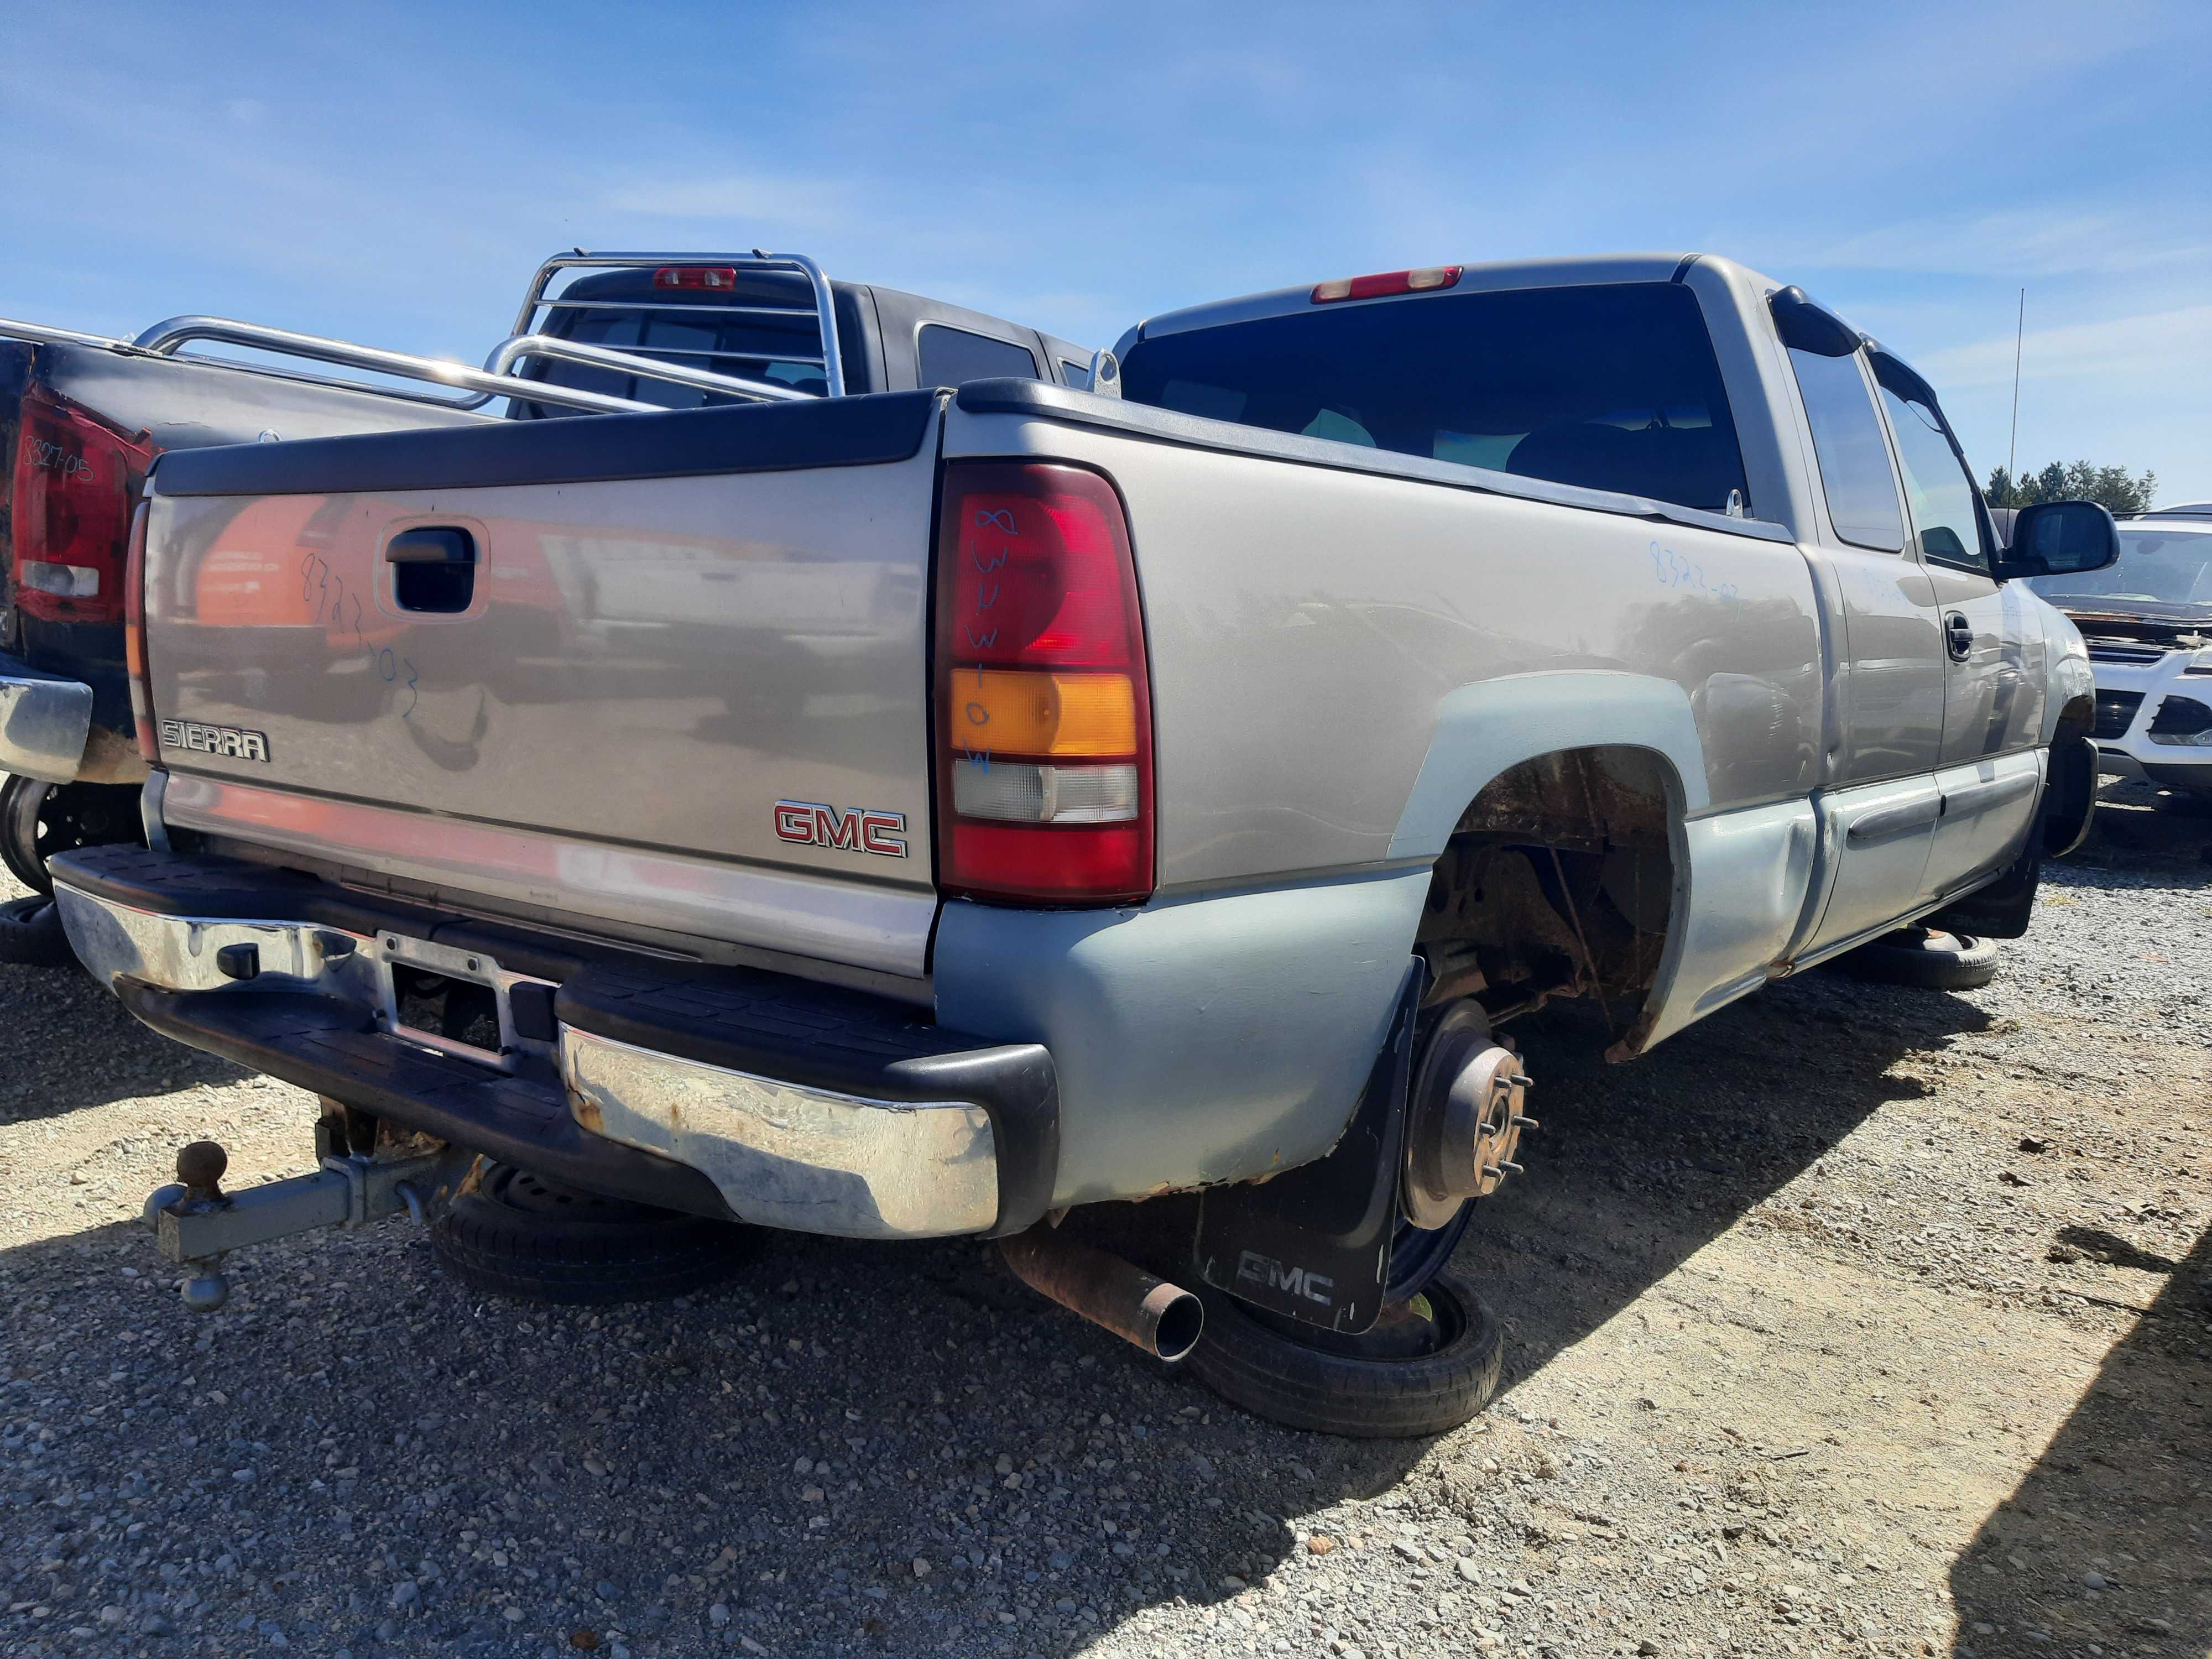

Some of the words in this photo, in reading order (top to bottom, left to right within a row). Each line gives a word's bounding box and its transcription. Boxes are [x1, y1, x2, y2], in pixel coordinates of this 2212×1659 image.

[24, 435, 94, 482] 8327-05
[163, 719, 270, 763] SIERRA
[774, 799, 908, 859] GMC
[1238, 1250, 1334, 1306] GMC
